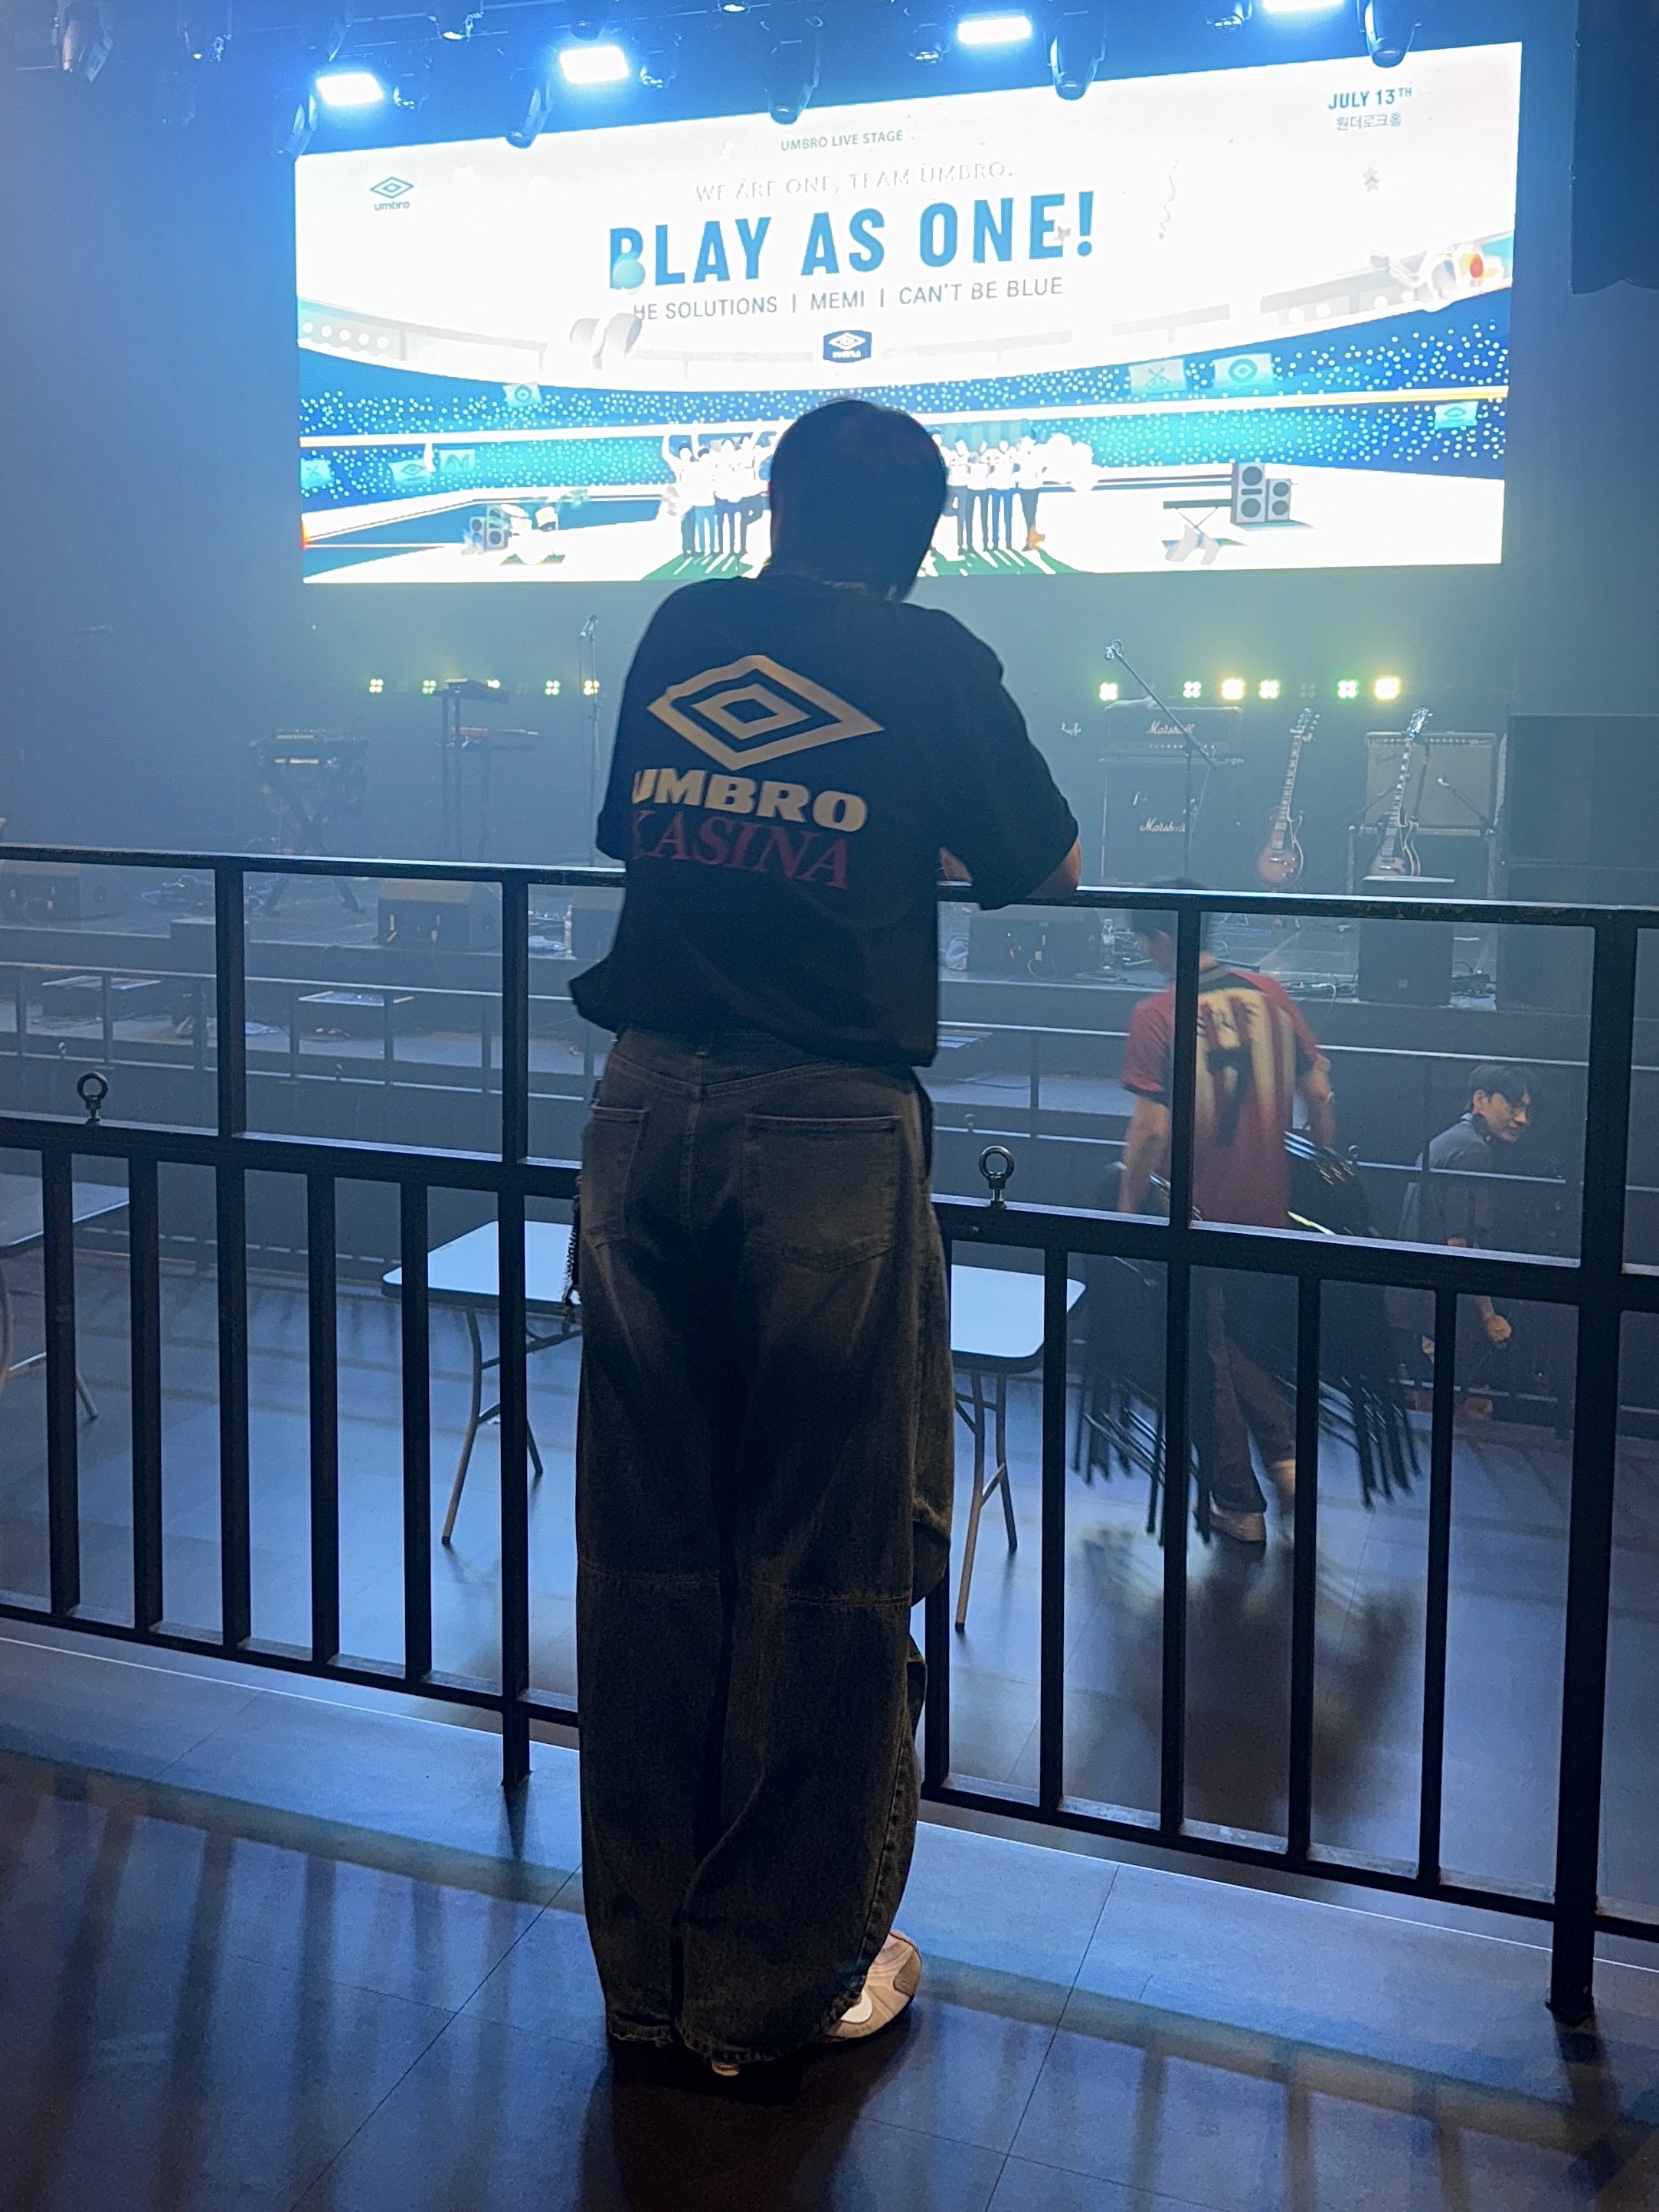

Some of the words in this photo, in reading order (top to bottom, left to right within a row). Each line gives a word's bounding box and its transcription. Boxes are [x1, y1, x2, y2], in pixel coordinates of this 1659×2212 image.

[1327, 91, 1370, 110] JULY
[781, 136, 829, 152] UMBRO
[832, 134, 859, 146] LIVE
[862, 129, 903, 144] STAGE
[374, 201, 411, 211] umbro
[610, 216, 772, 290] PLAY
[801, 208, 885, 276] AS
[919, 191, 1094, 267] ONE!
[633, 303, 658, 320] HE
[666, 296, 777, 320] SOLUTIONS
[810, 290, 865, 310] MEMI
[899, 283, 962, 305] CAN'T
[971, 281, 997, 300] BE
[1006, 276, 1062, 298] BLUE
[1147, 719, 1196, 735] Marshll
[631, 767, 868, 833] UMBRO
